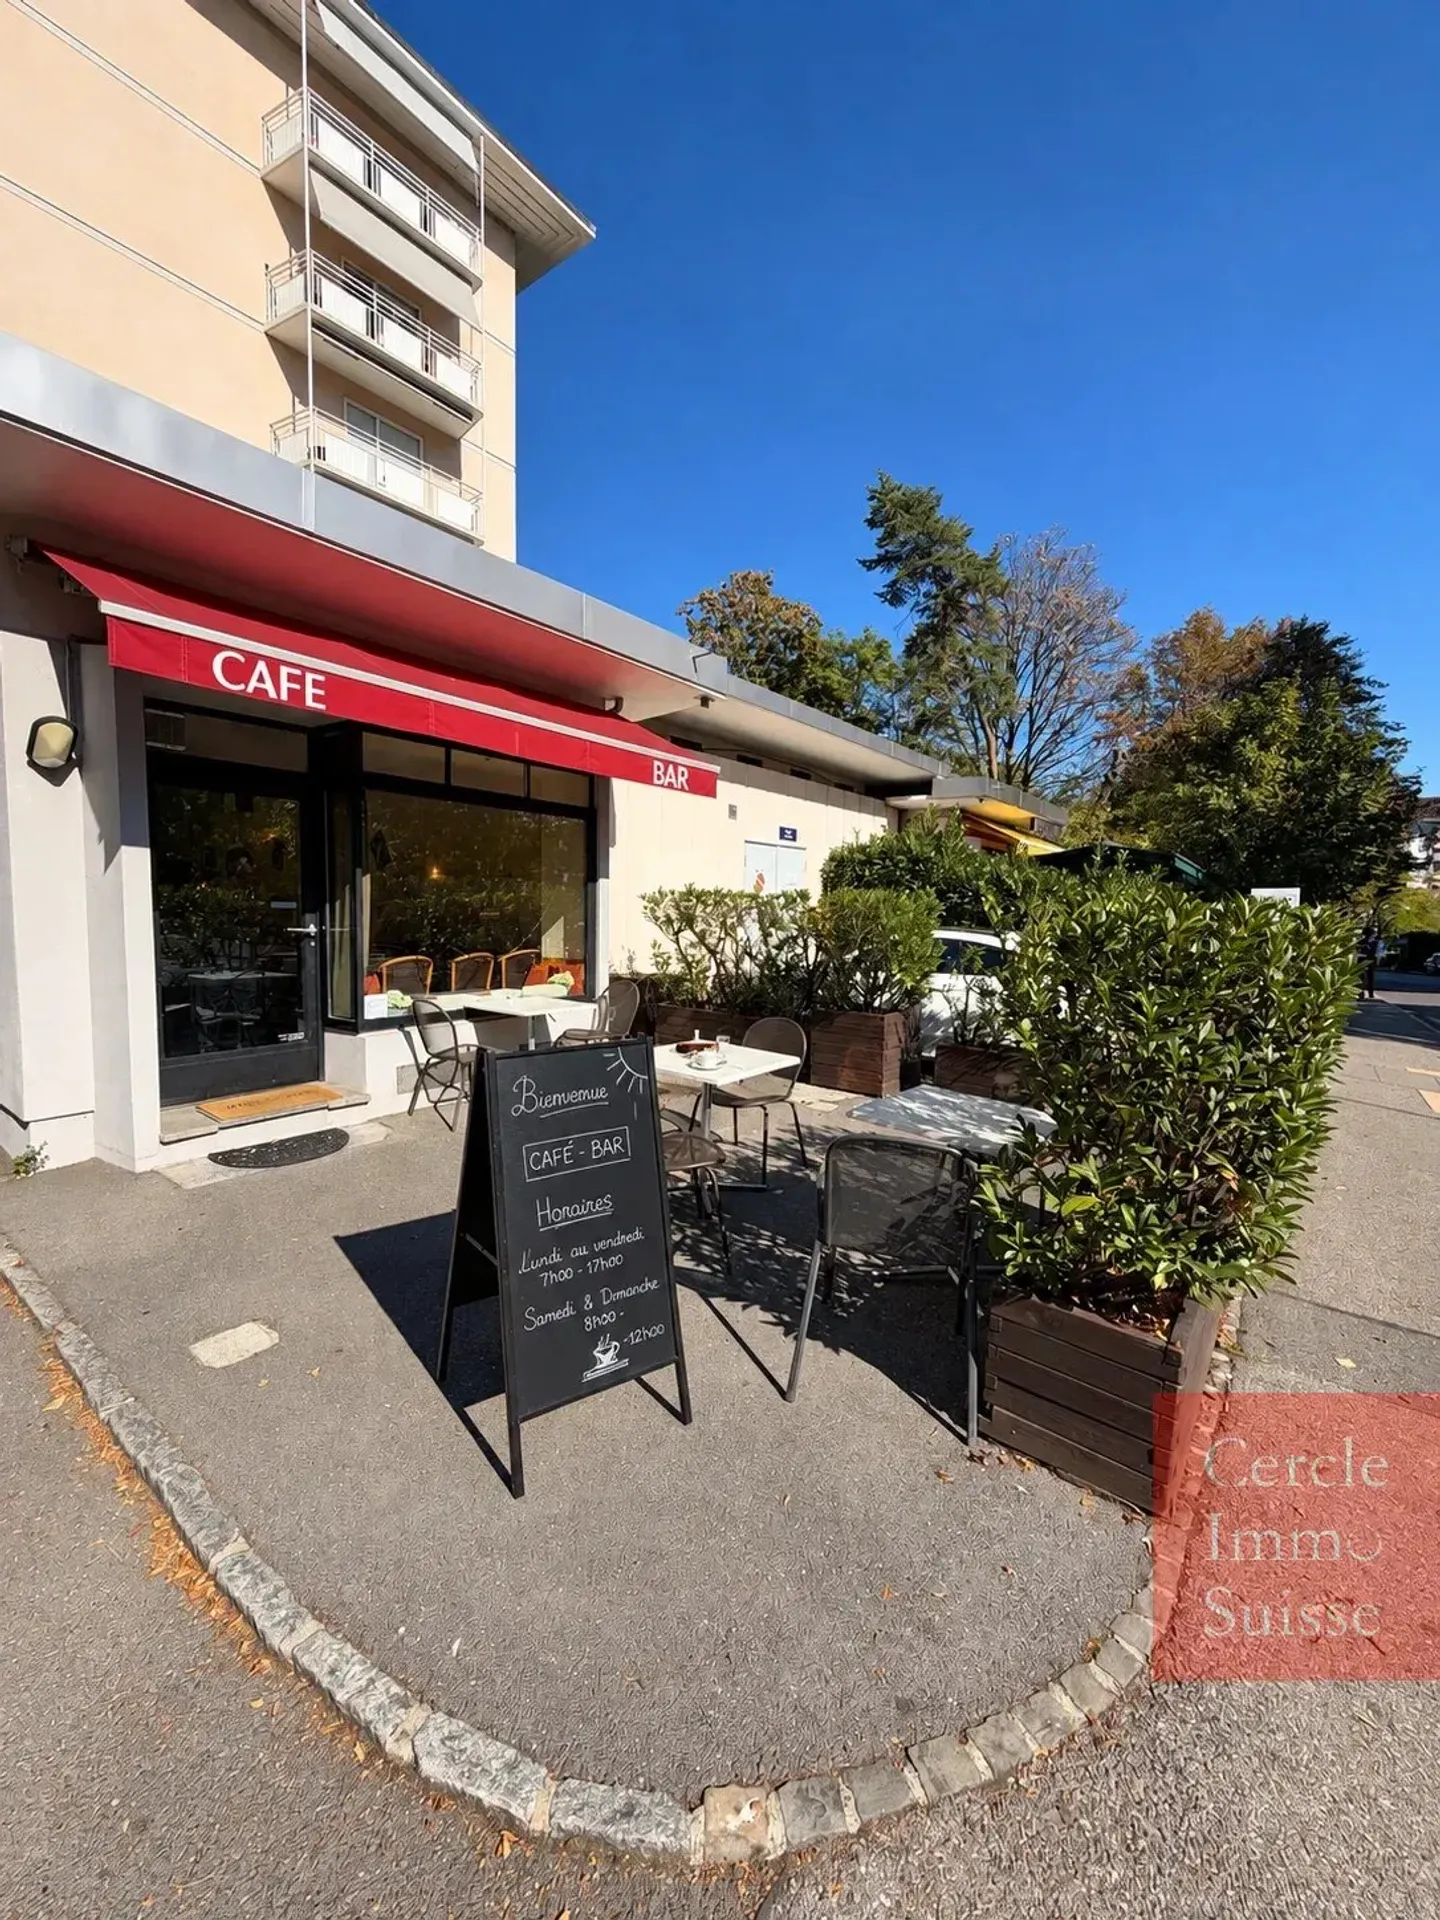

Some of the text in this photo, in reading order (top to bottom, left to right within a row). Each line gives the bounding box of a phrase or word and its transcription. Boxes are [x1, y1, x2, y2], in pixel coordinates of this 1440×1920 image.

[212, 650, 327, 711] CAFE
[652, 758, 691, 792] BAR
[529, 1139, 574, 1171] CAFÉ
[591, 1135, 625, 1160] BAR
[536, 1194, 613, 1227] Horaires
[570, 1244, 589, 1258] au
[539, 1267, 573, 1287] 7h00
[586, 1254, 624, 1274] 17h00
[523, 1301, 577, 1331] Samedi
[583, 1294, 593, 1310] &
[584, 1311, 616, 1332] 8h00
